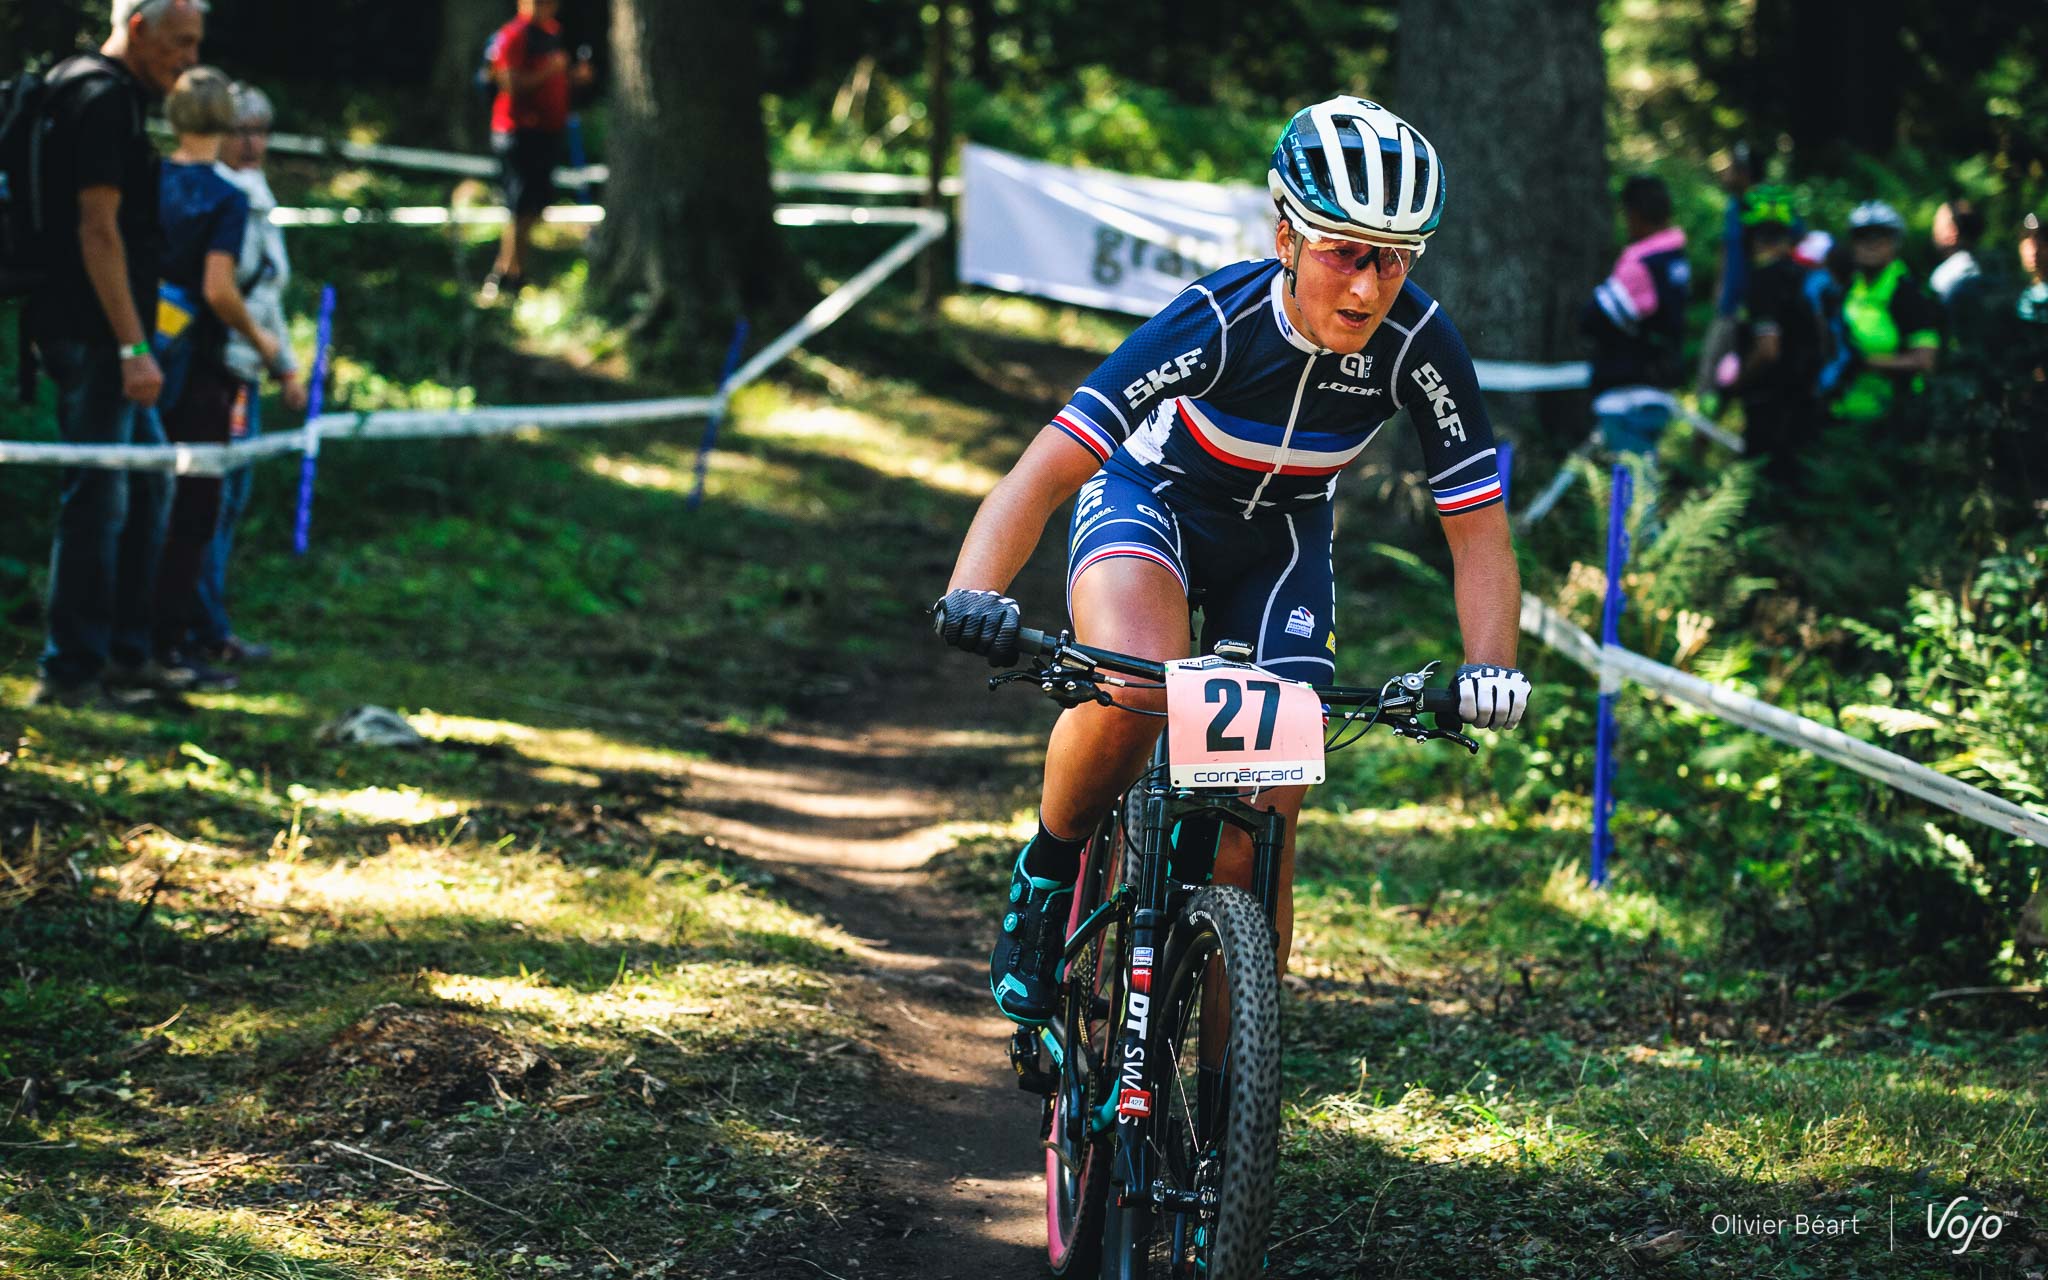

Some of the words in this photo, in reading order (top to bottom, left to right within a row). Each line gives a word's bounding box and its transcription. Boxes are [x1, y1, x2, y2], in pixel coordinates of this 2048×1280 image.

[1122, 347, 1203, 410] SKF
[1317, 381, 1382, 396] LOOK
[1410, 362, 1467, 442] SKF
[1204, 678, 1281, 752] 27
[1126, 992, 1150, 1040] DT
